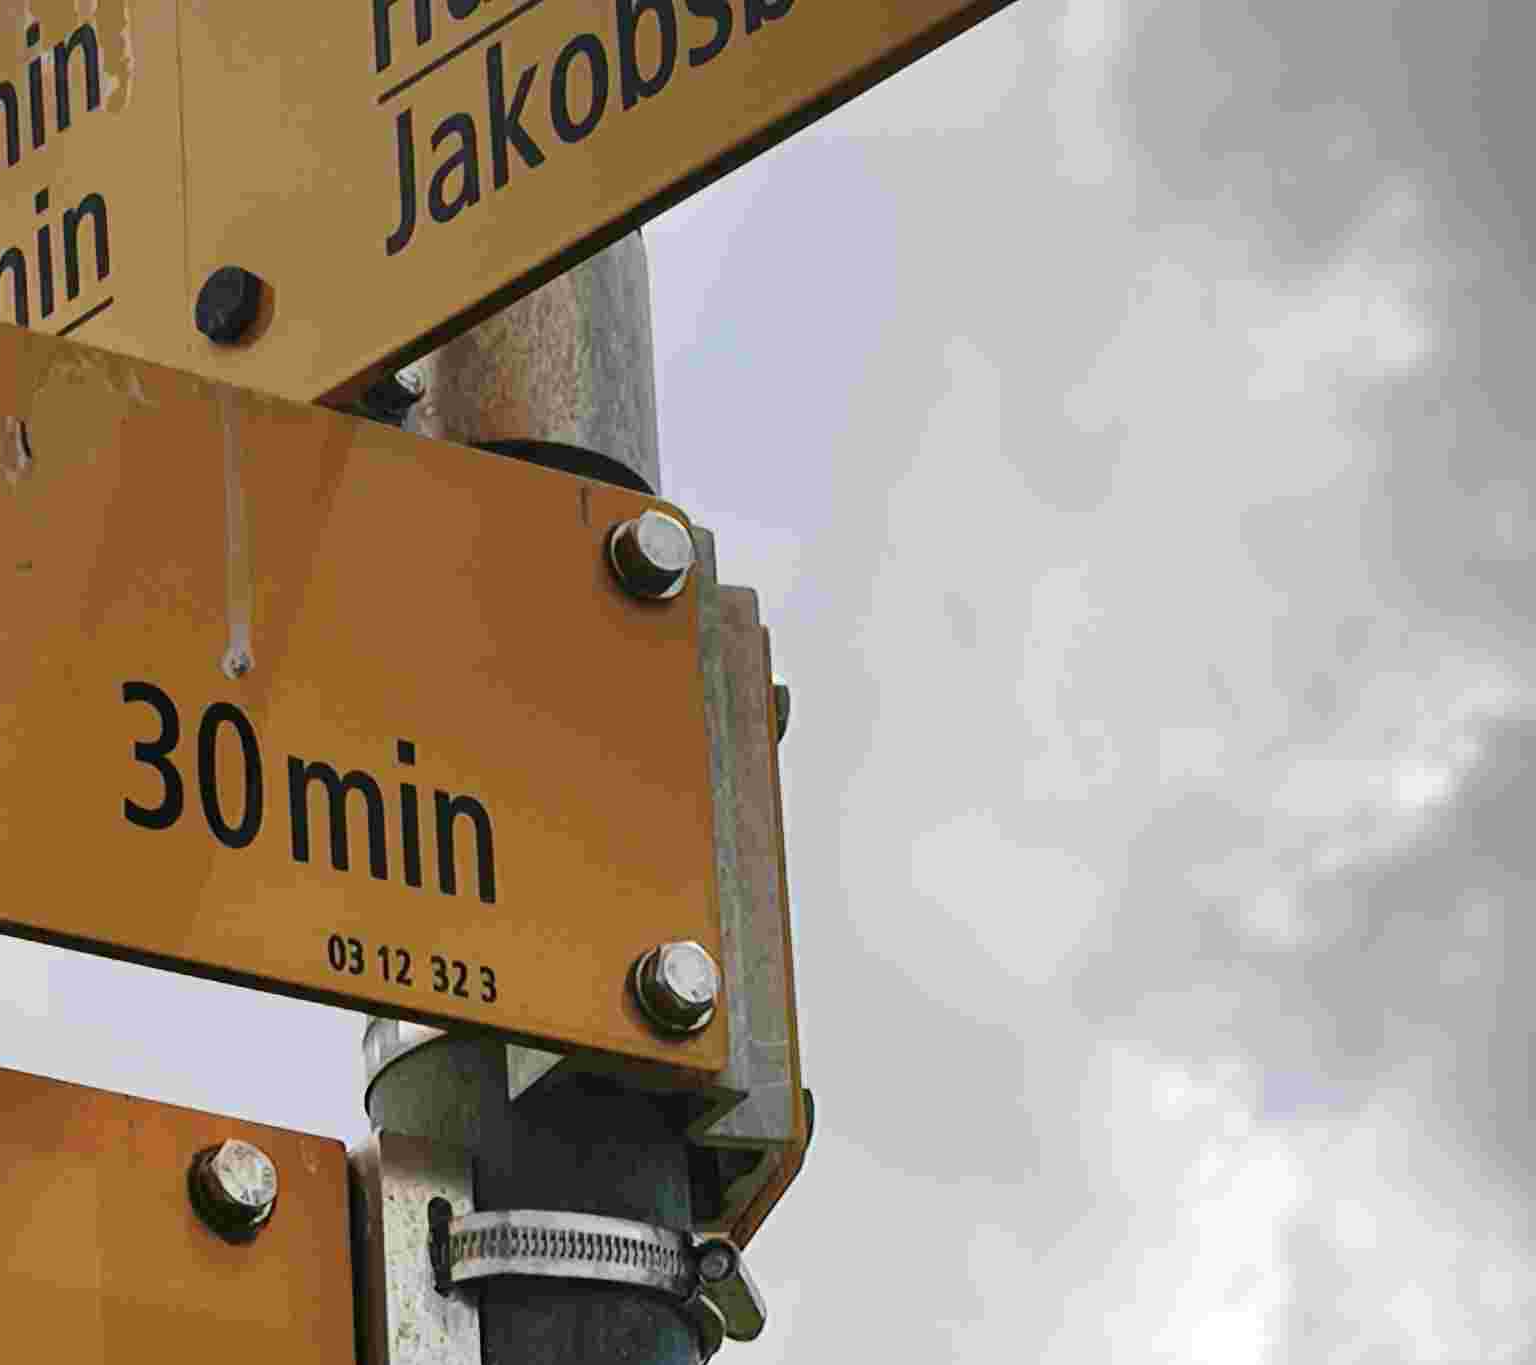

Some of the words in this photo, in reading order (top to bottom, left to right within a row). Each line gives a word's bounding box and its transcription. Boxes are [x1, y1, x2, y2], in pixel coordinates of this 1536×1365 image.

[384, 0, 794, 257] Jakobs
[327, 933, 365, 976] 03
[376, 945, 413, 988] 12
